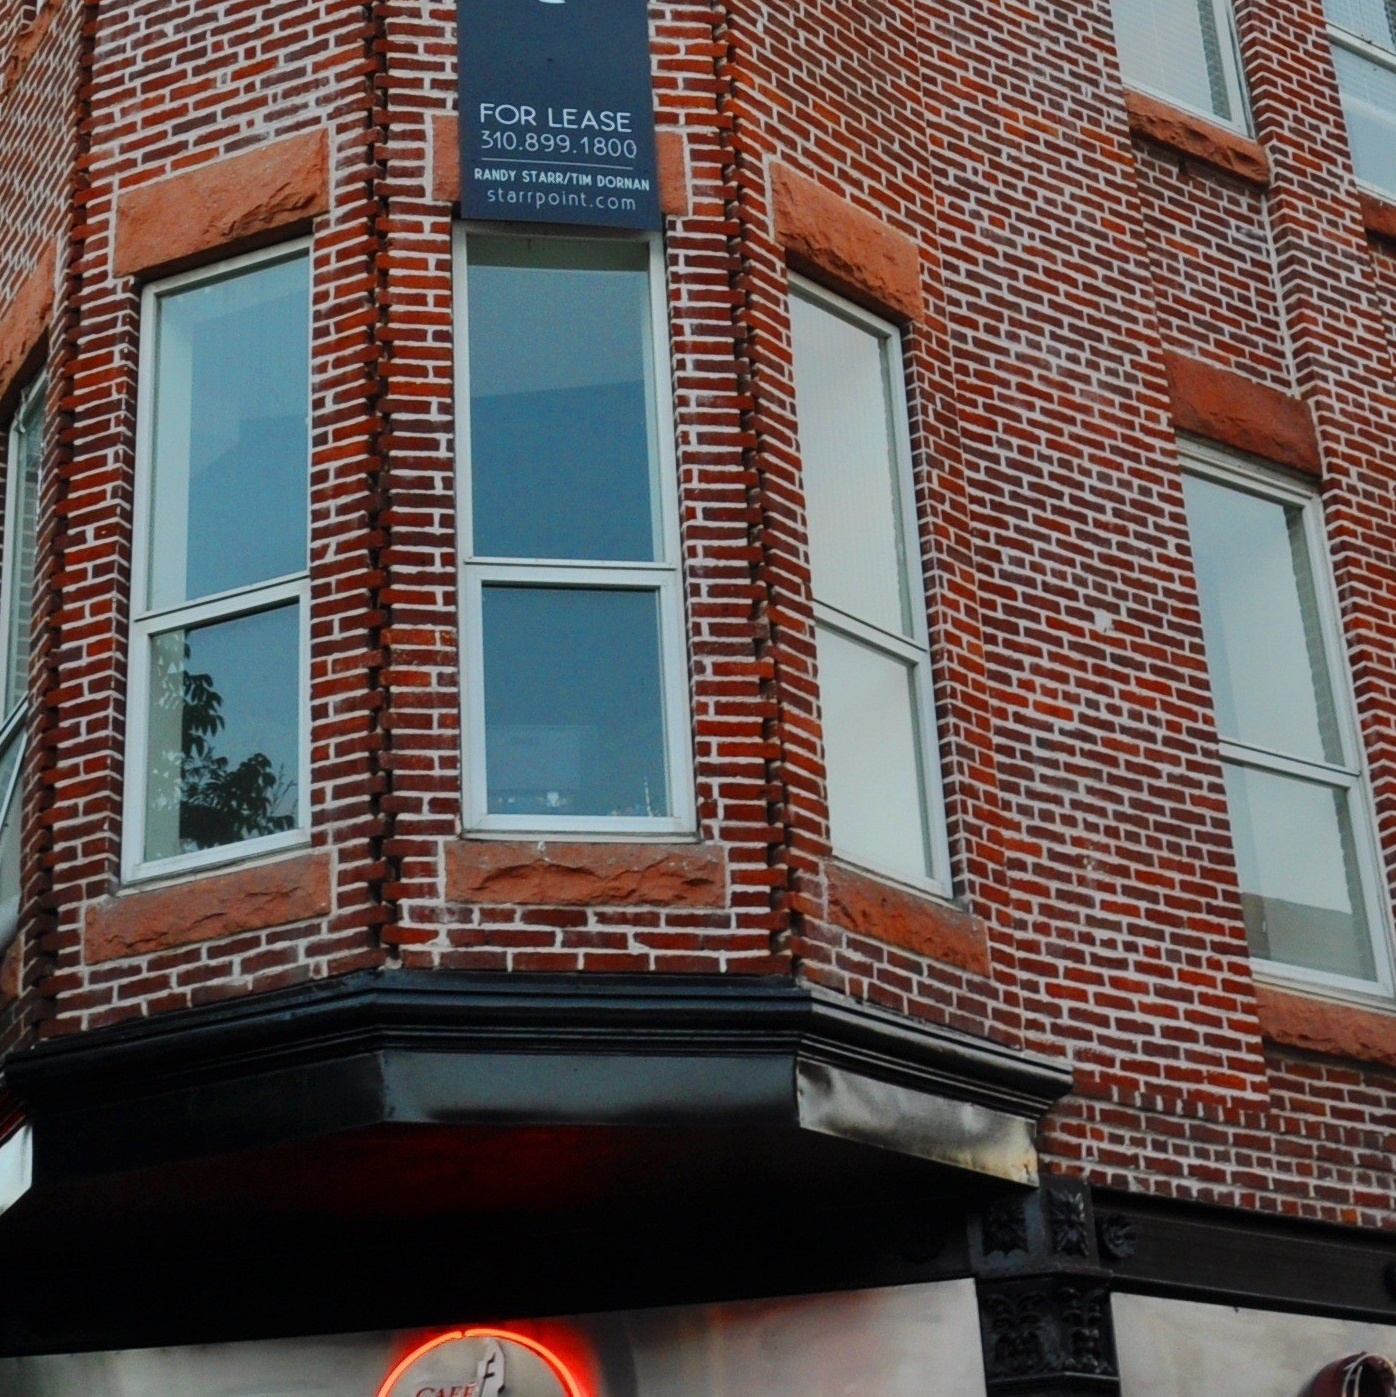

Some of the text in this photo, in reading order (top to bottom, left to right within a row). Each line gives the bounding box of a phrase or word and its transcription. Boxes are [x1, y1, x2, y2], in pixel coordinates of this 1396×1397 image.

[479, 102, 633, 133] FOR LEASE
[480, 130, 638, 159] 310.899.1800
[474, 167, 651, 192] RANDY STARR/TIM DORNAN
[486, 188, 637, 211] starrpoint.com
